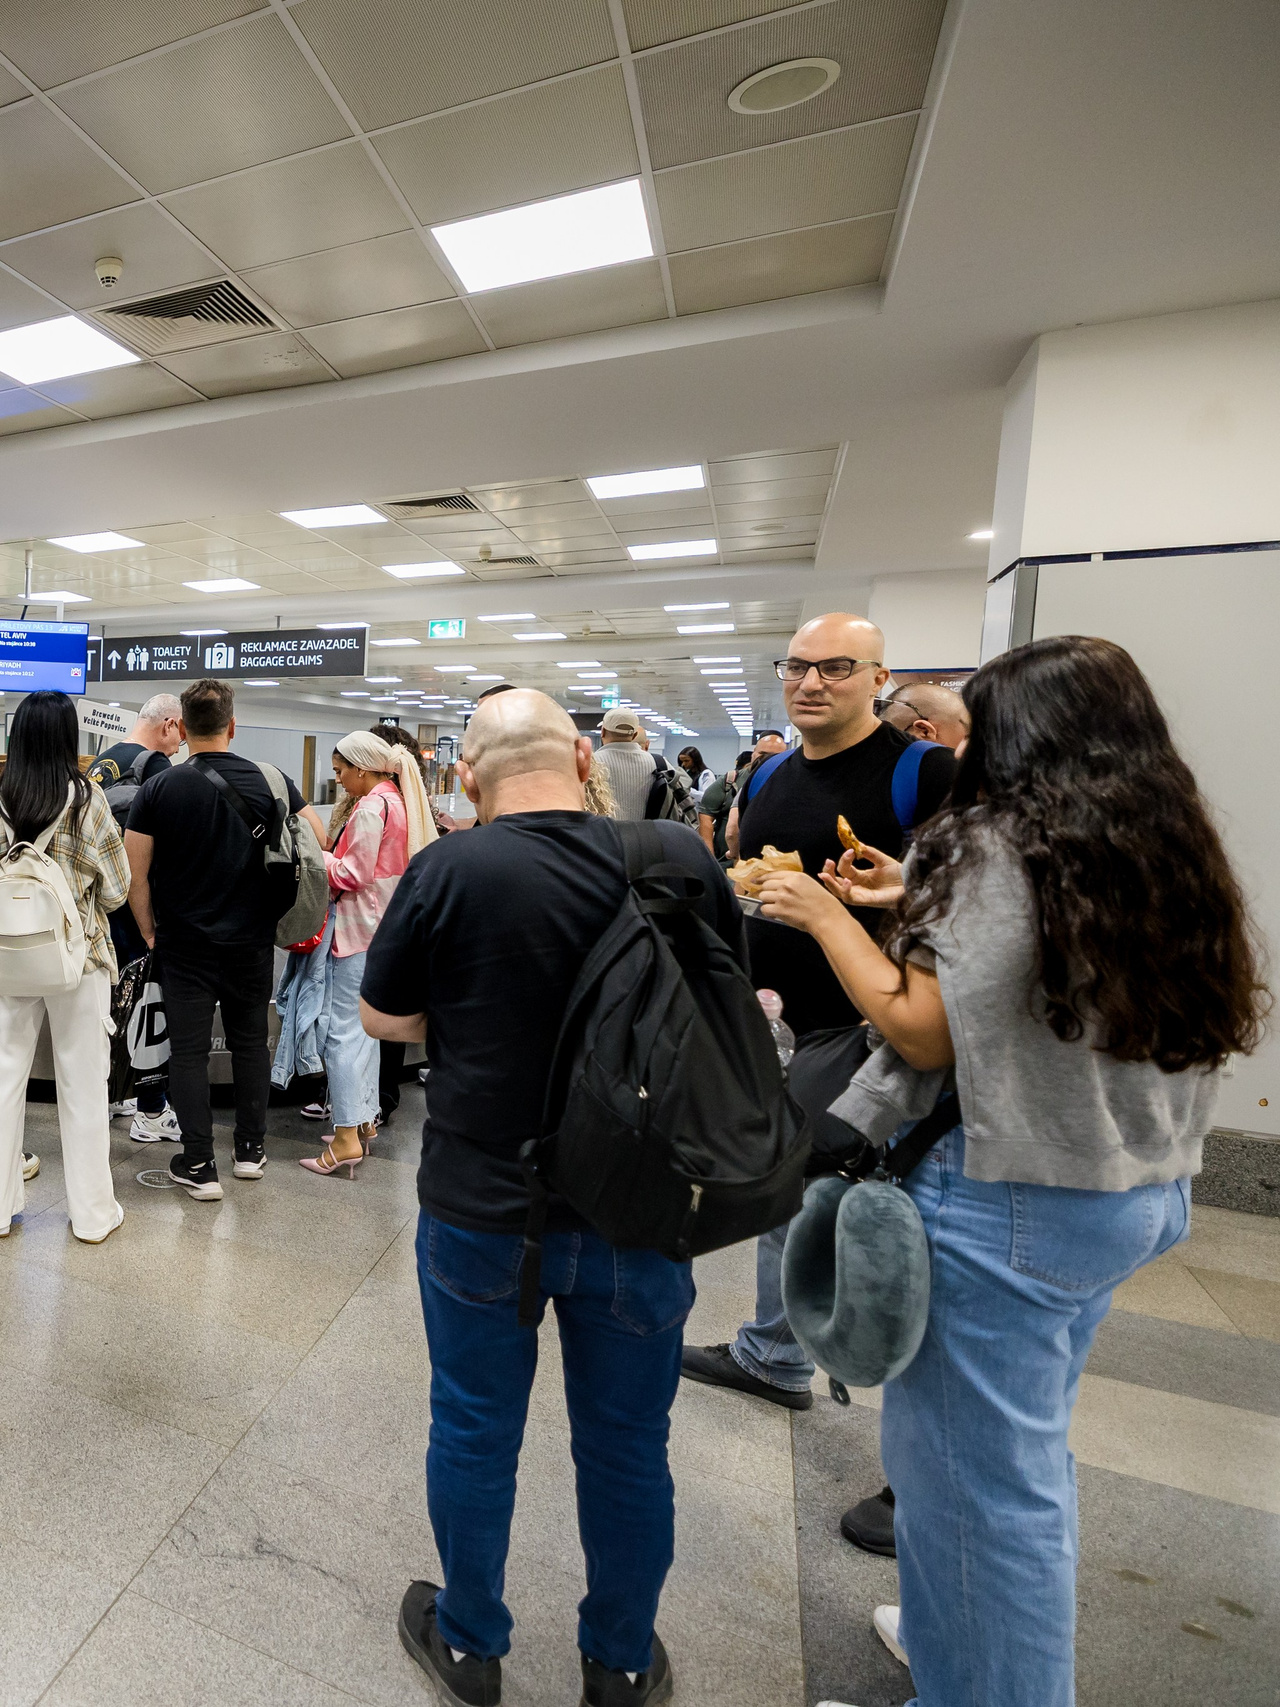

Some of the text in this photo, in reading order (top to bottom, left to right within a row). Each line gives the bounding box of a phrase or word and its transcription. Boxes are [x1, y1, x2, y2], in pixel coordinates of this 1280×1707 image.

[240, 638, 359, 652] REKLAMACE ZAVAZADEL
[153, 646, 191, 657] TOALETY
[152, 660, 188, 670] TOILETS
[240, 655, 323, 667] BAGGAGE CLAIMS
[92, 709, 121, 722] Brewed in
[100, 720, 127, 733] Popovice
